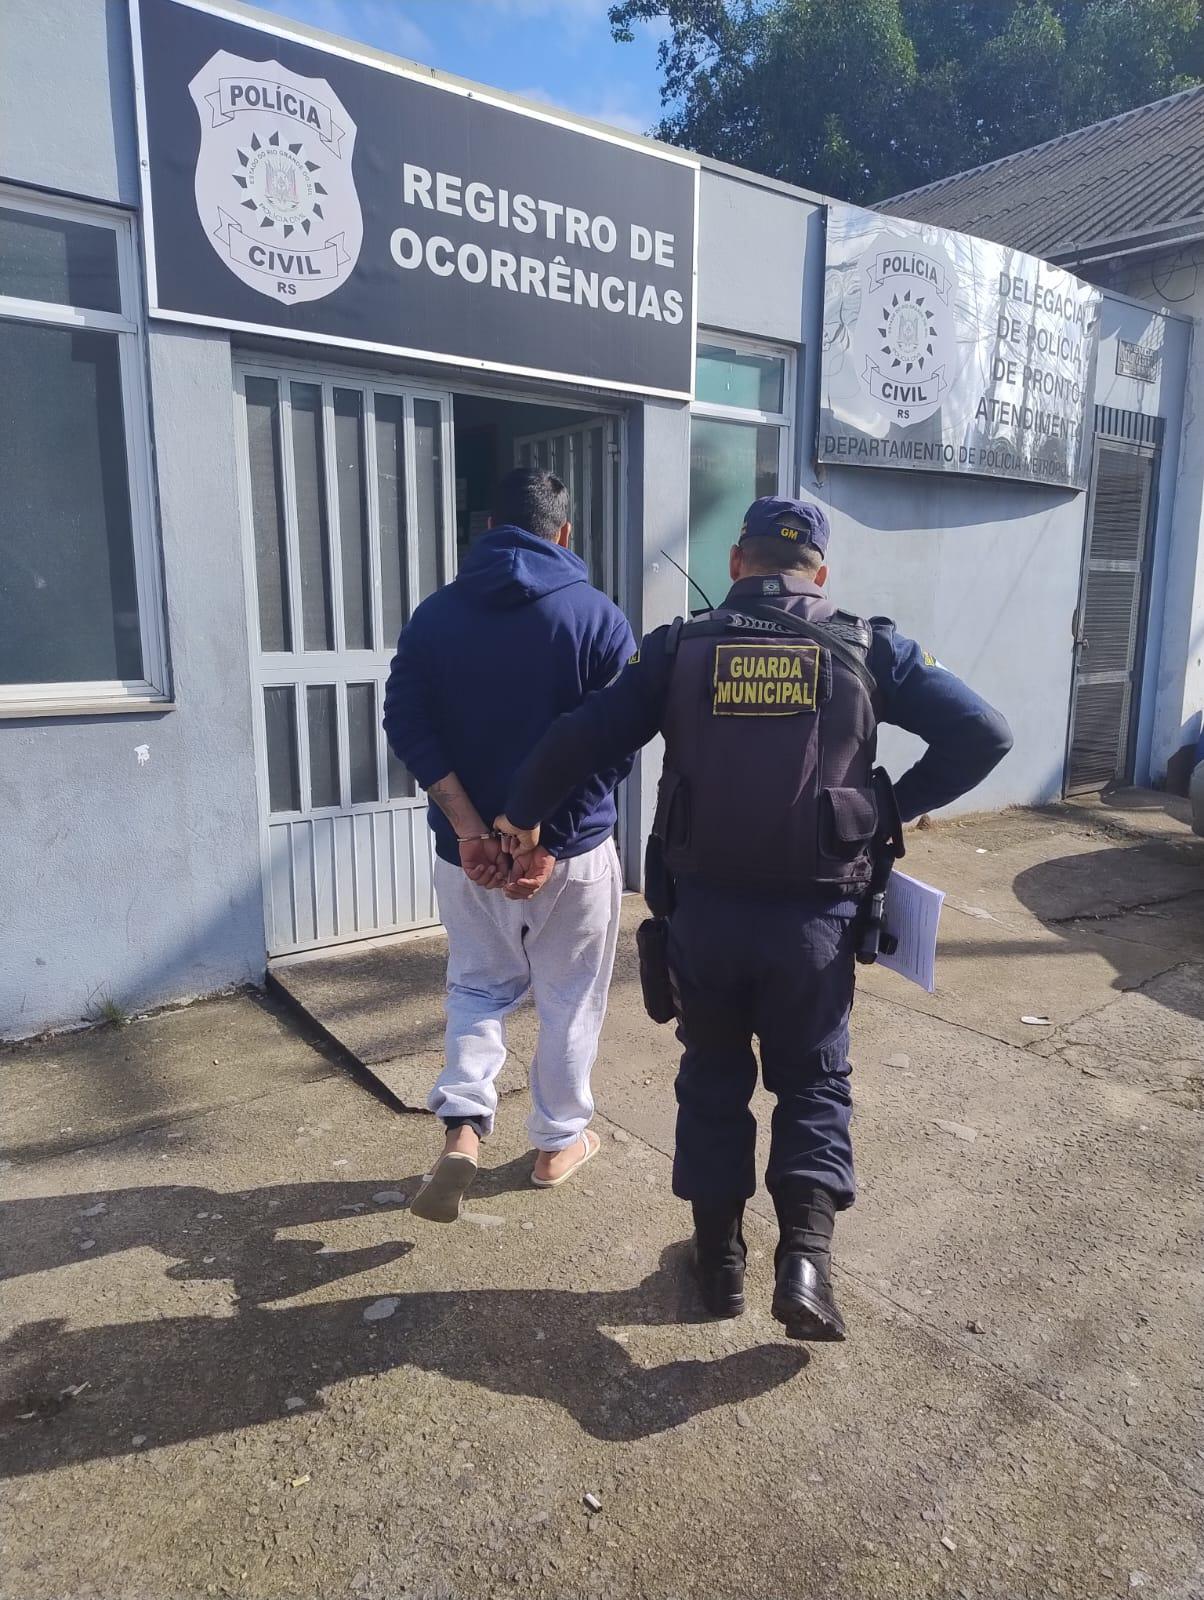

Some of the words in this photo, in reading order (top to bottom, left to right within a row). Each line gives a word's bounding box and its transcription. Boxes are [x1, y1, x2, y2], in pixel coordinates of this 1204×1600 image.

[230, 86, 321, 129] POLÍCIA
[403, 163, 617, 253] REGISTRO
[630, 224, 675, 268] DE
[249, 246, 321, 275] CIVIL
[883, 254, 937, 284] POLÍCIA
[277, 282, 296, 295] RS
[390, 227, 684, 325] OCORRÊNCIAS
[999, 272, 1084, 324] DELEGACIA
[997, 315, 1021, 344] DE
[882, 383, 927, 402] CIVIL
[993, 357, 1017, 385] DE
[1022, 365, 1080, 404] PRONTO
[897, 409, 910, 419] RS
[824, 435, 954, 462] DEPARTAMENTO
[958, 445, 976, 465] DE
[781, 527, 798, 541] GM
[730, 656, 803, 679] GUARDA
[717, 681, 813, 705] MUNICIPAL
